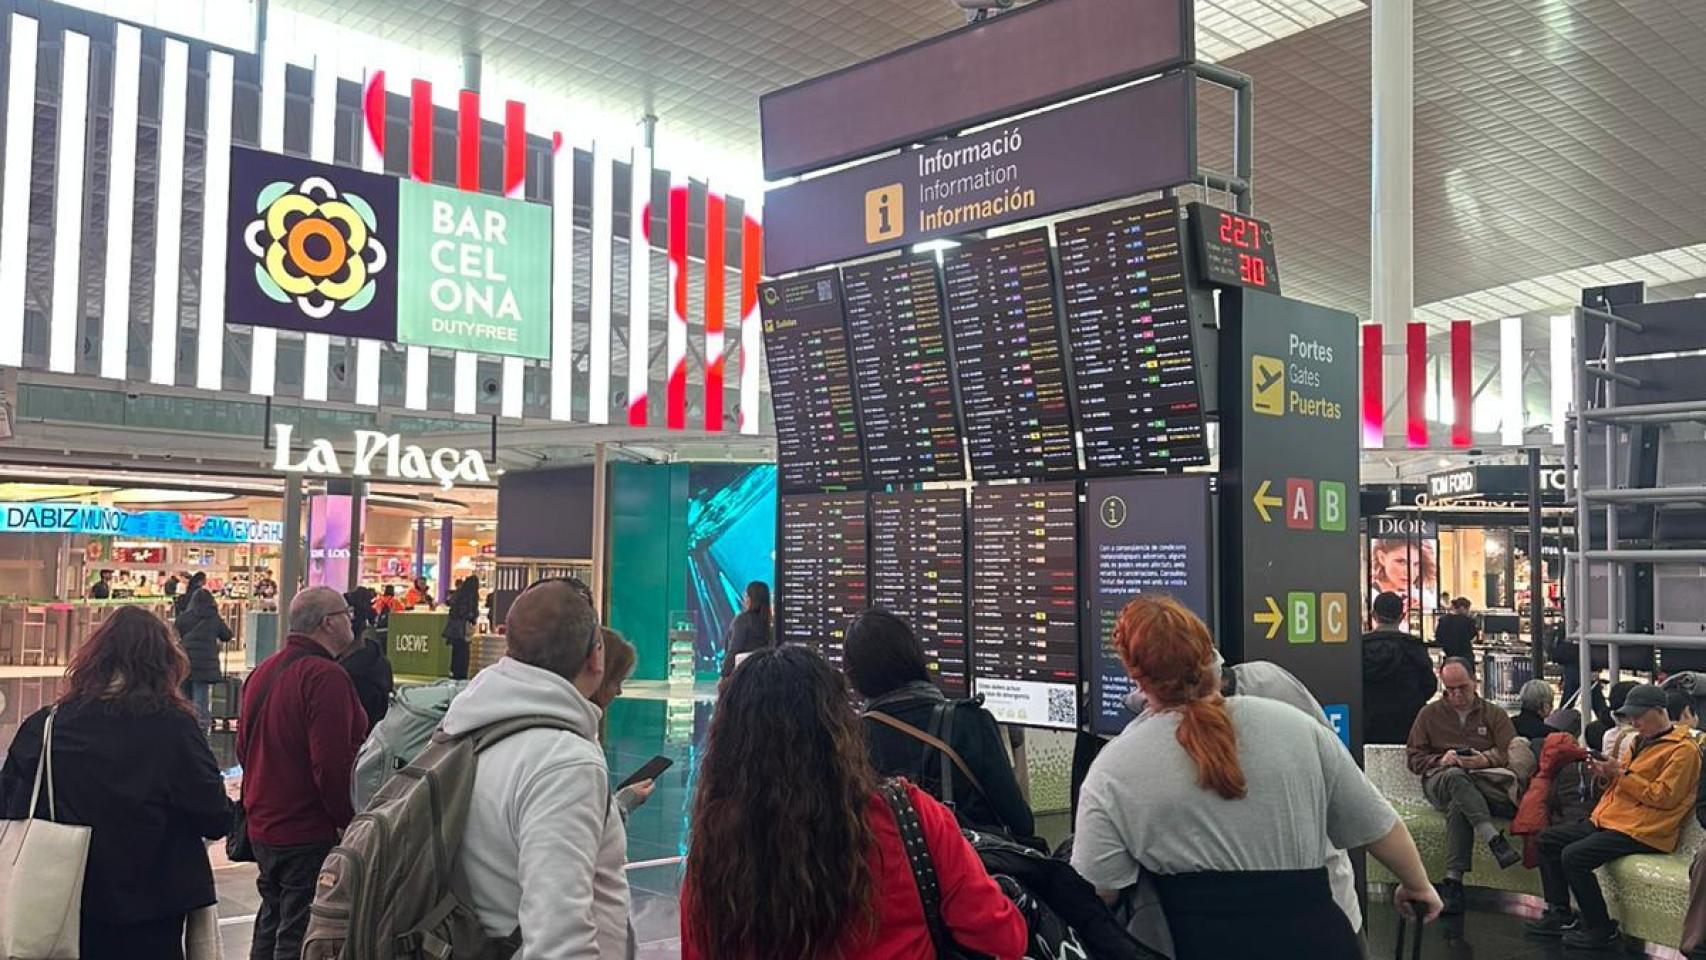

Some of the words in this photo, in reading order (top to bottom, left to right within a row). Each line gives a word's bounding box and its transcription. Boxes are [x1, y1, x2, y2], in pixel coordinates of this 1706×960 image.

[919, 128, 1023, 177] Informació
[920, 163, 1018, 203] Information
[432, 200, 508, 245] BAR
[920, 187, 1035, 232] Información
[430, 240, 507, 281] CEL
[1239, 253, 1265, 286] 30
[430, 278, 523, 321] ONA
[1289, 333, 1333, 363] Portes
[1290, 363, 1320, 387] Gates
[1290, 390, 1342, 419] Puertas
[273, 423, 342, 474] La
[353, 430, 490, 490] Plaça
[1430, 476, 1448, 496] TOM
[1449, 471, 1474, 493] FORD
[7, 507, 79, 529] DABIZ
[81, 507, 129, 531] MUÑOZ
[1293, 487, 1309, 520] A
[1326, 490, 1339, 522] B
[1379, 518, 1427, 535] DIOR
[1295, 600, 1309, 634] B
[1327, 600, 1343, 634] C
[396, 634, 429, 652] LOEWE
